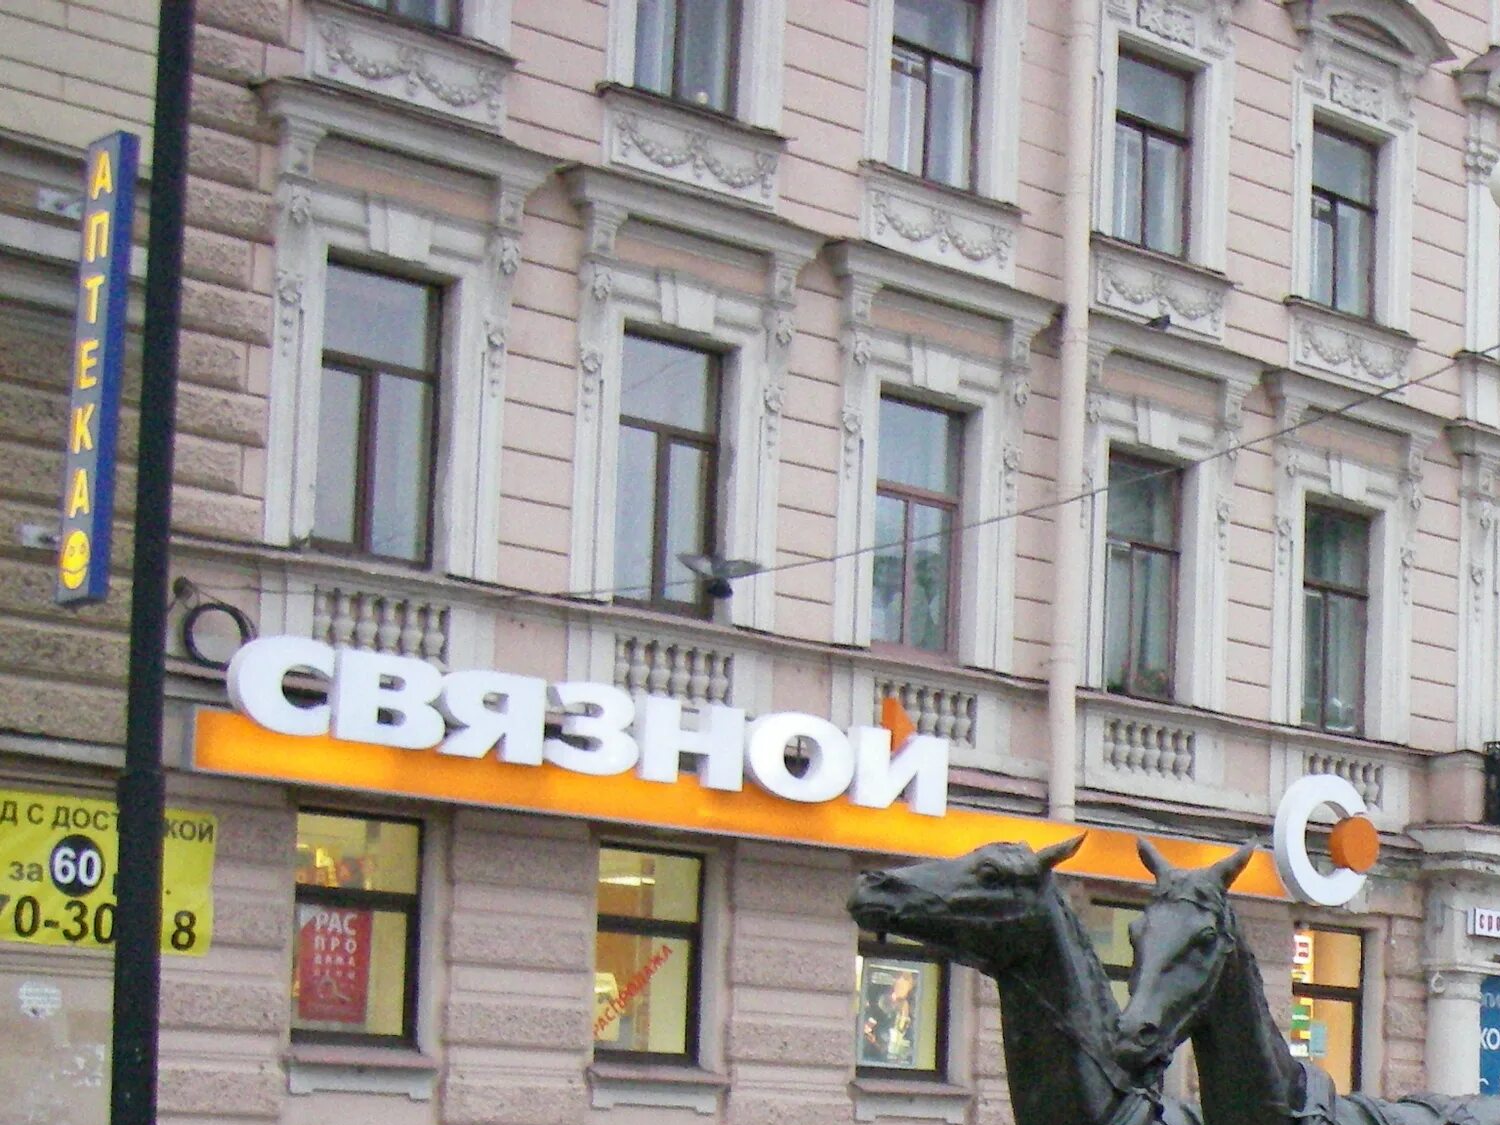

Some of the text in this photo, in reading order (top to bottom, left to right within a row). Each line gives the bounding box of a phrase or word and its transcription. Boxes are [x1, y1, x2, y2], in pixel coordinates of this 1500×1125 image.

[68, 149, 114, 520] АПТЕКА
[226, 634, 949, 817] СВЯЗНОЙ
[54, 847, 101, 888] 60
[314, 935, 357, 955] ПРО
